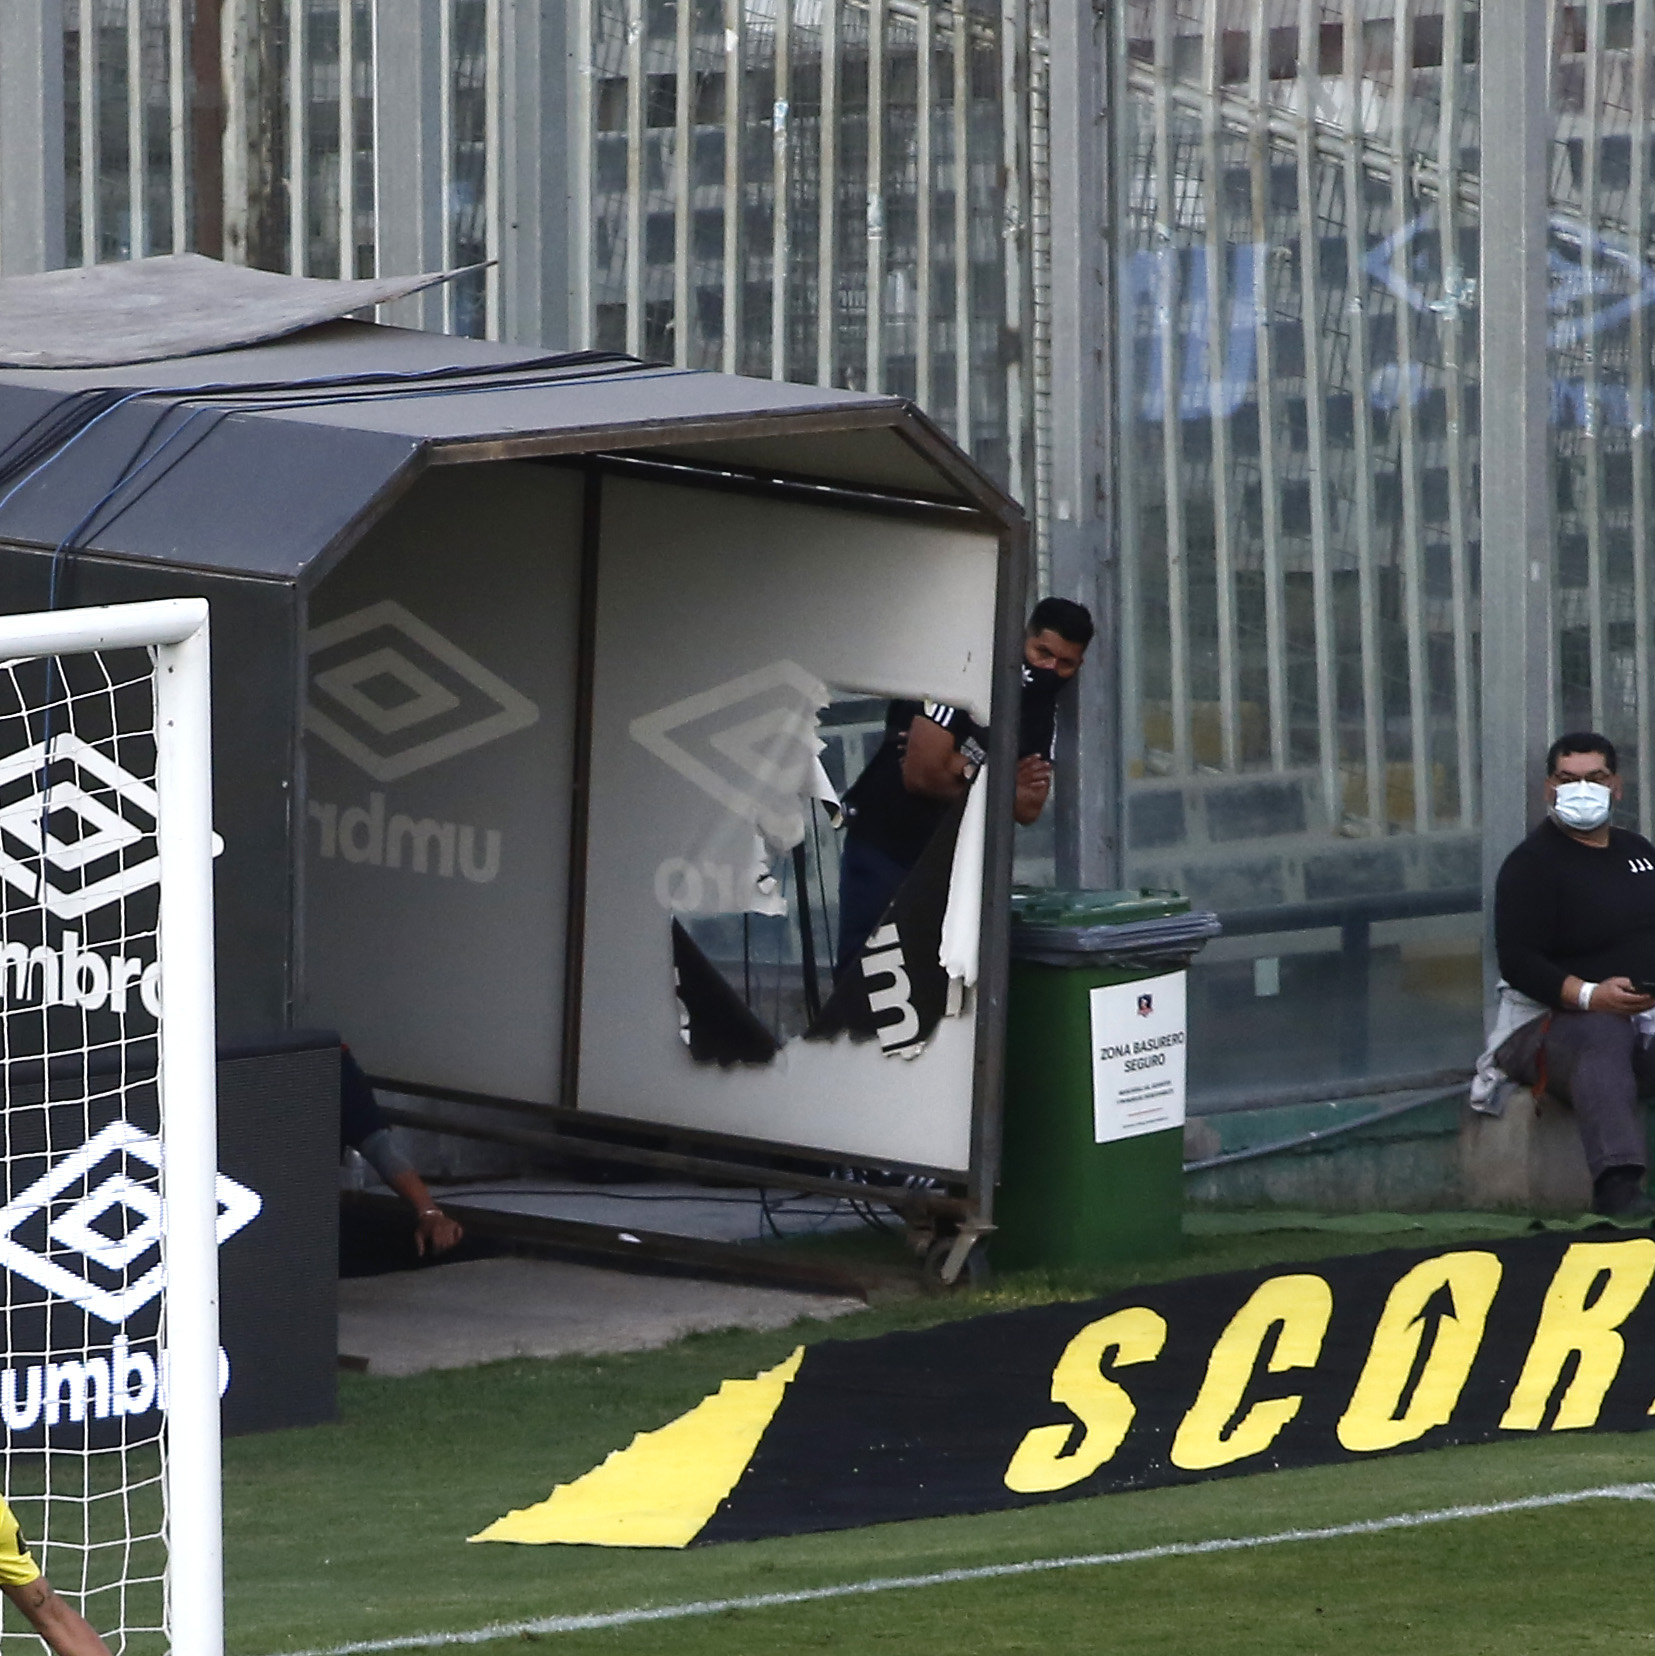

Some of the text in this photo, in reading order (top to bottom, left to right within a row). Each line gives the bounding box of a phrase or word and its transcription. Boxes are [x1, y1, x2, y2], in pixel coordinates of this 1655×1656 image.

[1100, 1031, 1185, 1060] ZONA BASURERO
[1124, 1053, 1166, 1073] SEGURO
[0, 1334, 231, 1431] umb
